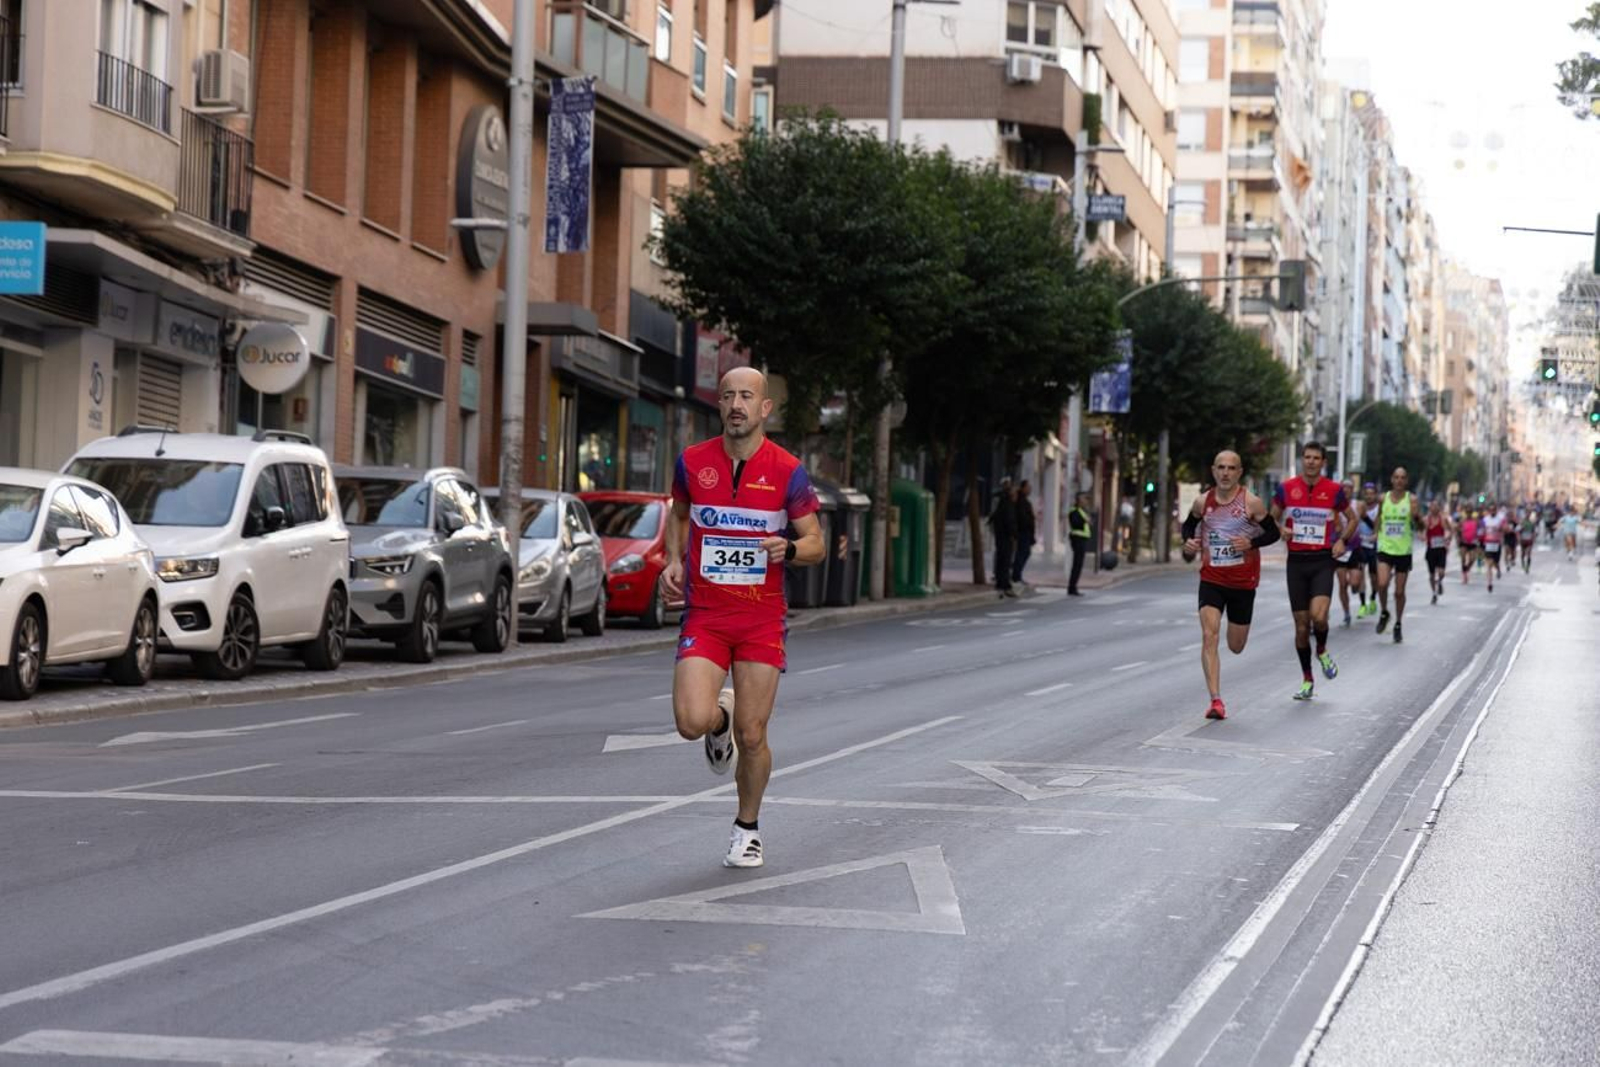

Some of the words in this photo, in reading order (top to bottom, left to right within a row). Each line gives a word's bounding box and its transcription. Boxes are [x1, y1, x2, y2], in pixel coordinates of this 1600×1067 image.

[719, 512, 768, 529] Avanza
[1302, 526, 1316, 535] 13
[714, 550, 756, 567] 345
[1214, 546, 1237, 558] 749
